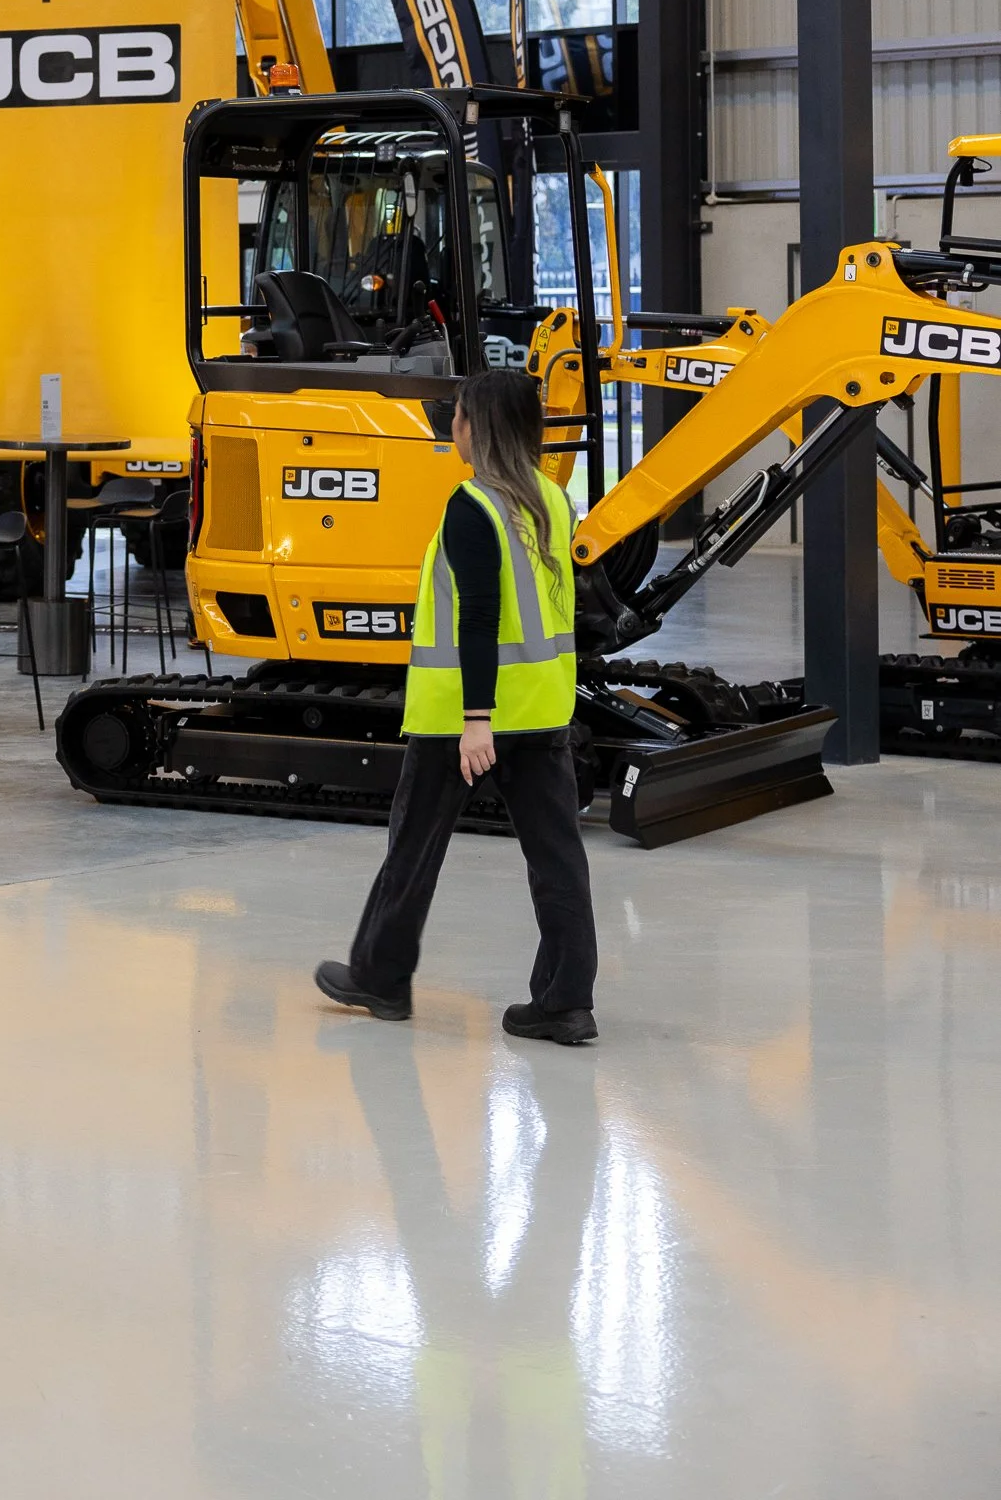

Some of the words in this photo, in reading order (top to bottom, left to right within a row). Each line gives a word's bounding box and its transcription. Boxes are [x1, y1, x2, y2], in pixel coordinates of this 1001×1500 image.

[884, 321, 1001, 365] JCB
[284, 469, 377, 499] JCB
[345, 610, 397, 634] 25
